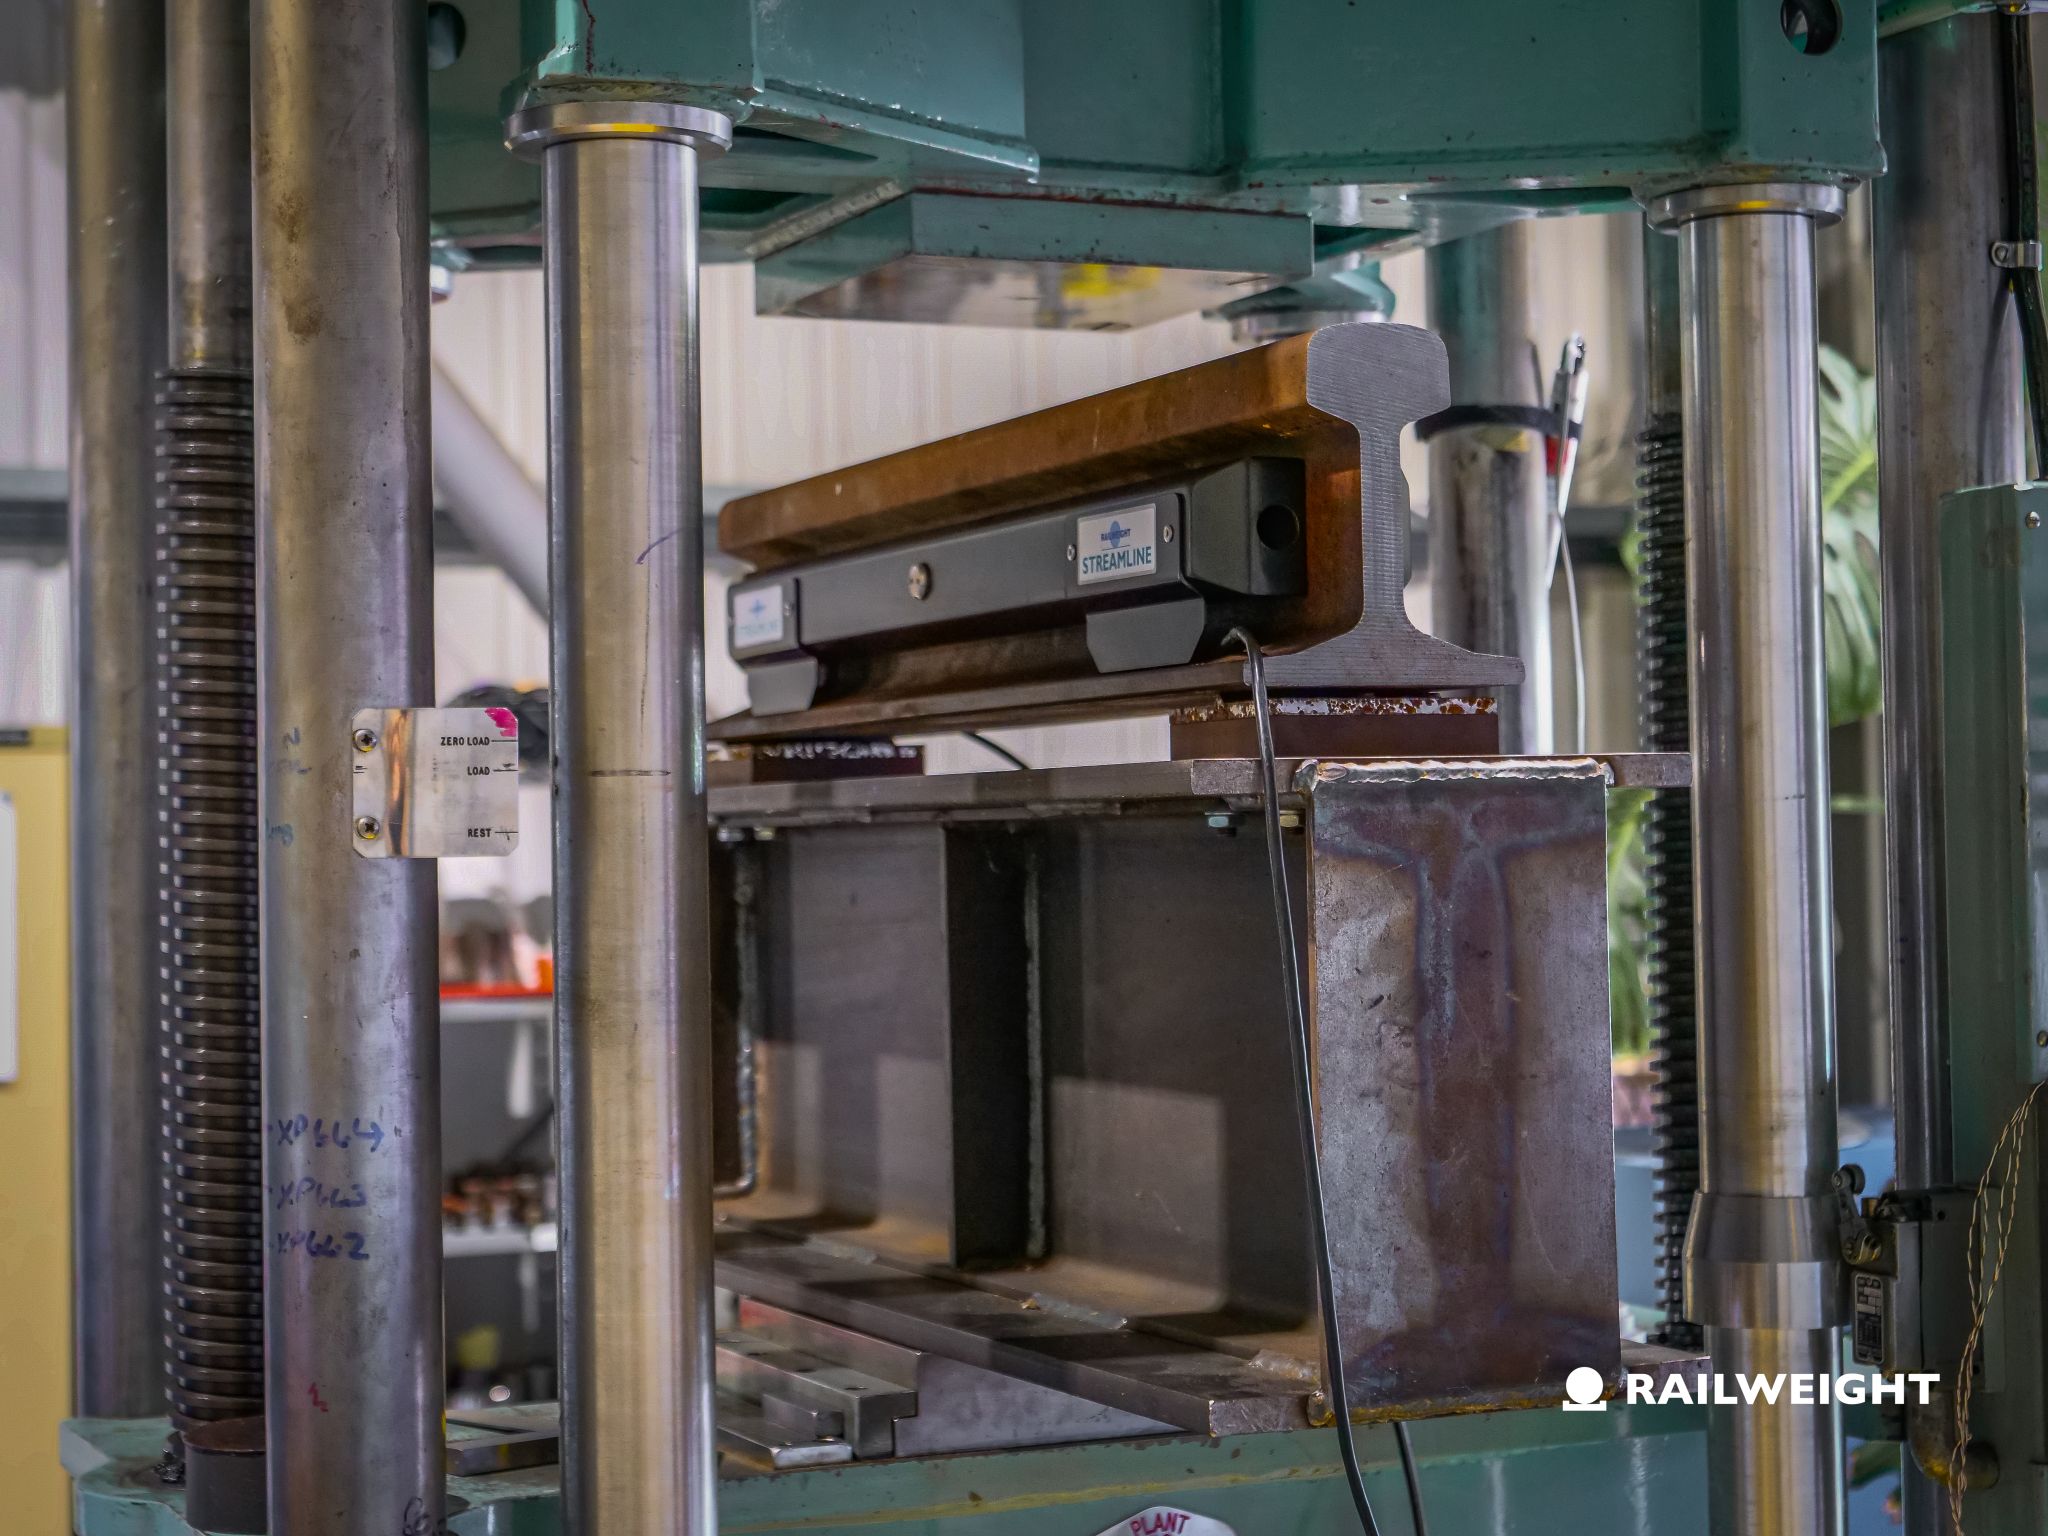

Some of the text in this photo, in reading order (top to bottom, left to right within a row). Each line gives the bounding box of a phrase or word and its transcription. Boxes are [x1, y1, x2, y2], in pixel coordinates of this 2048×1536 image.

[1082, 546, 1152, 574] STREAMLINE
[440, 736, 490, 746] ZERO LOAD
[467, 766, 490, 776] LOAD
[467, 828, 492, 838] REST
[1130, 1512, 1190, 1536] PLANT
